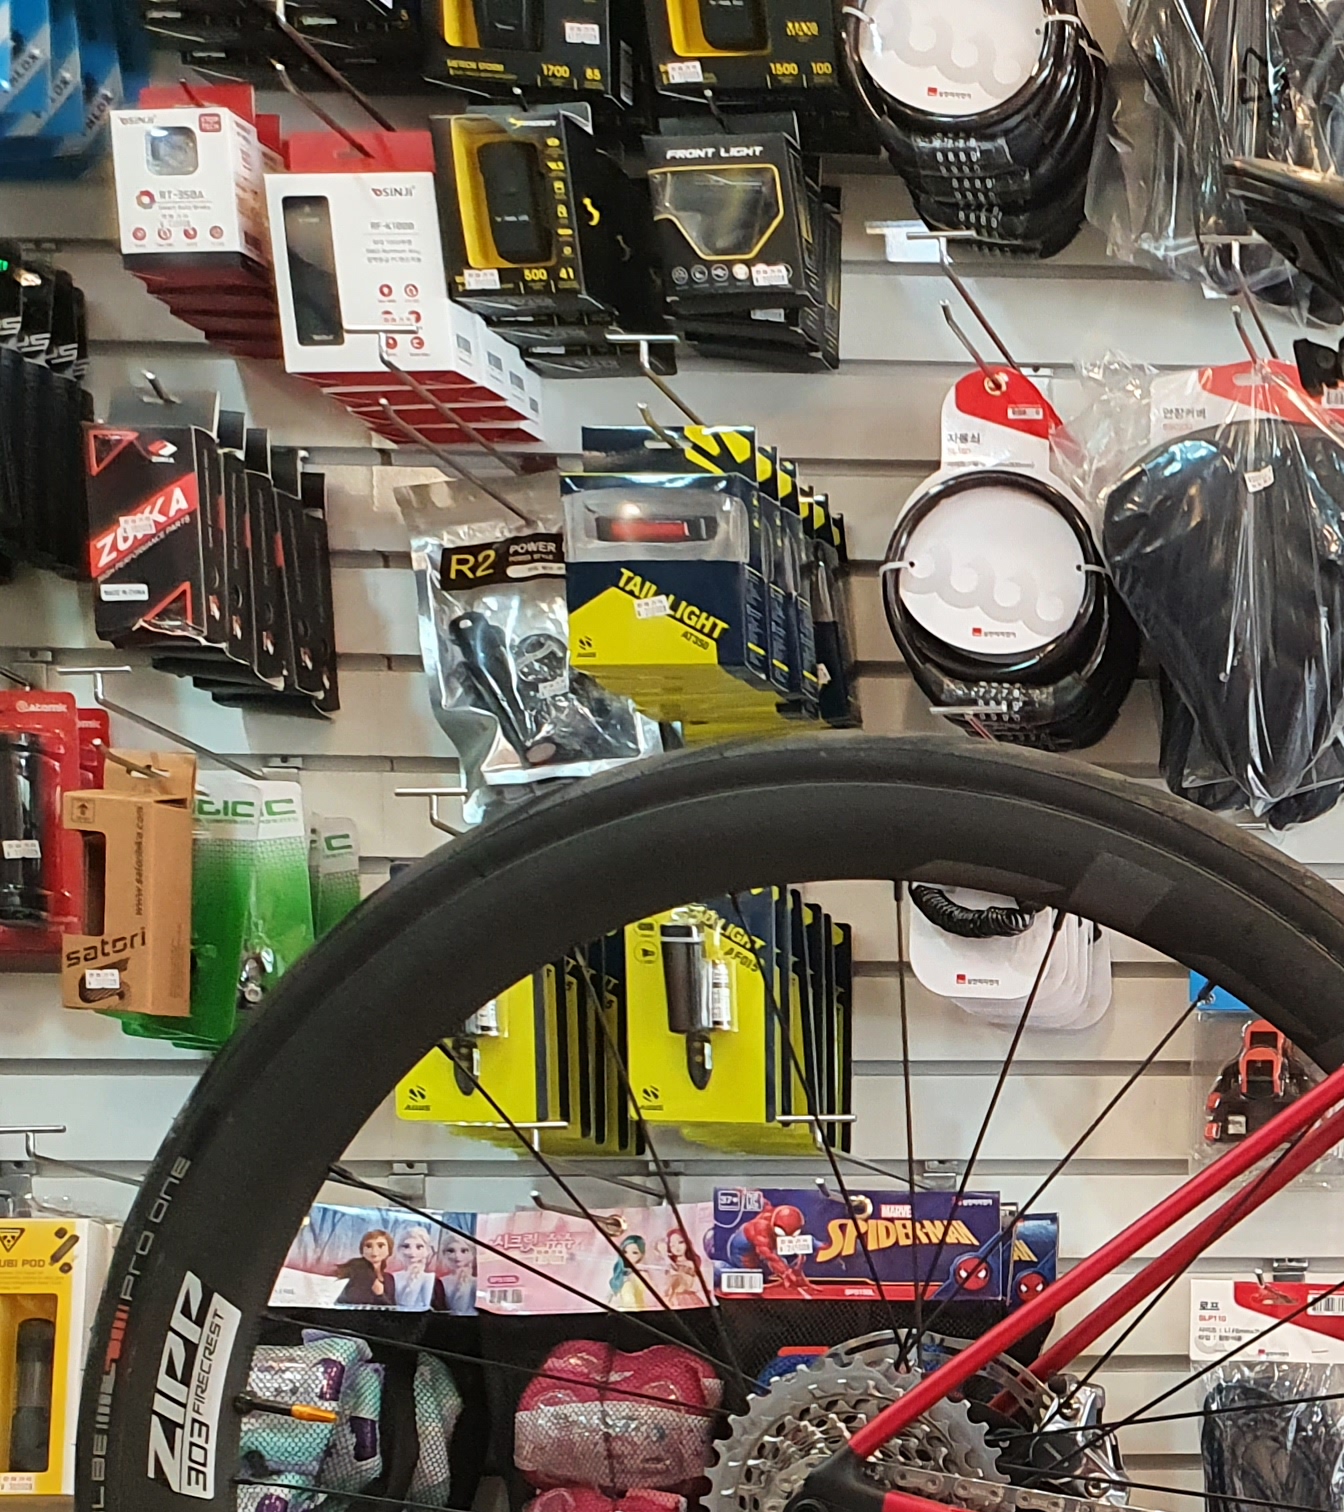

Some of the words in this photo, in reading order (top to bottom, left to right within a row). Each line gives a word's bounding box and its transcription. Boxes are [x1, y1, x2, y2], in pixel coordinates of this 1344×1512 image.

[541, 63, 570, 79] 1700
[769, 62, 799, 77] 1500
[811, 62, 833, 75] 100
[666, 146, 717, 161] FRONT
[719, 145, 765, 159] LIGHT
[523, 267, 548, 282] 500
[559, 266, 575, 280] 41
[509, 540, 557, 555] POWER
[449, 549, 496, 580] R2
[66, 927, 147, 968] satori
[816, 1218, 980, 1264] SPIDER-MAN
[22, 1259, 46, 1269] POD
[1198, 1300, 1221, 1310] 로프
[190, 1306, 227, 1418] FIRECREST
[146, 1269, 203, 1494] ZIPP
[185, 1420, 211, 1494] 303
